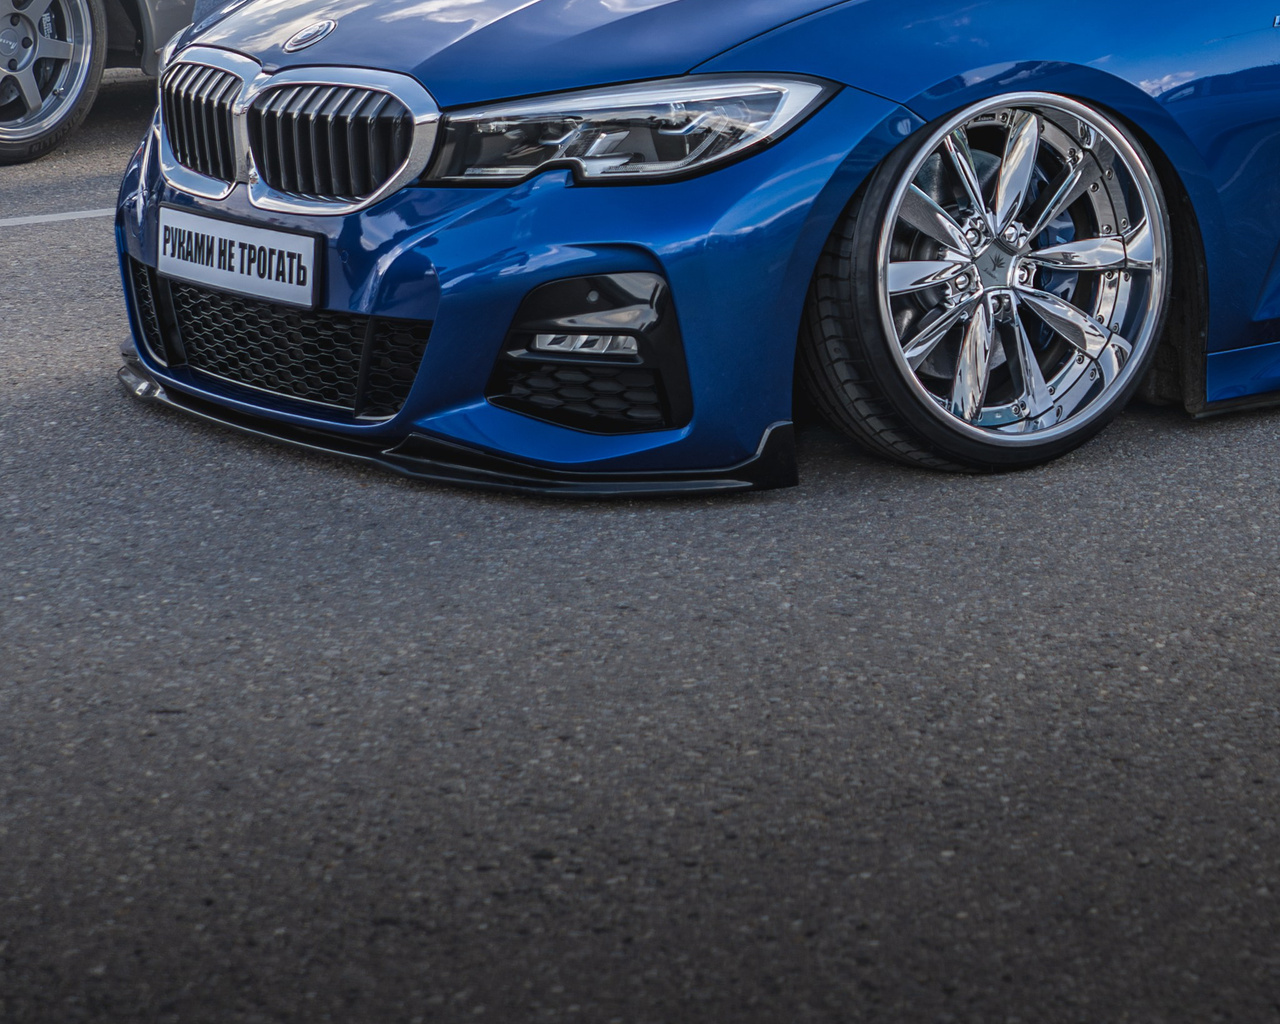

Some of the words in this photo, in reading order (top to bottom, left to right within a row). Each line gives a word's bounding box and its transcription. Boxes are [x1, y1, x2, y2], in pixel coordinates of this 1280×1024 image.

[163, 225, 215, 268] РУКАМИ
[217, 237, 236, 272] НЕ
[238, 242, 308, 286] ТРОГАТЬ
